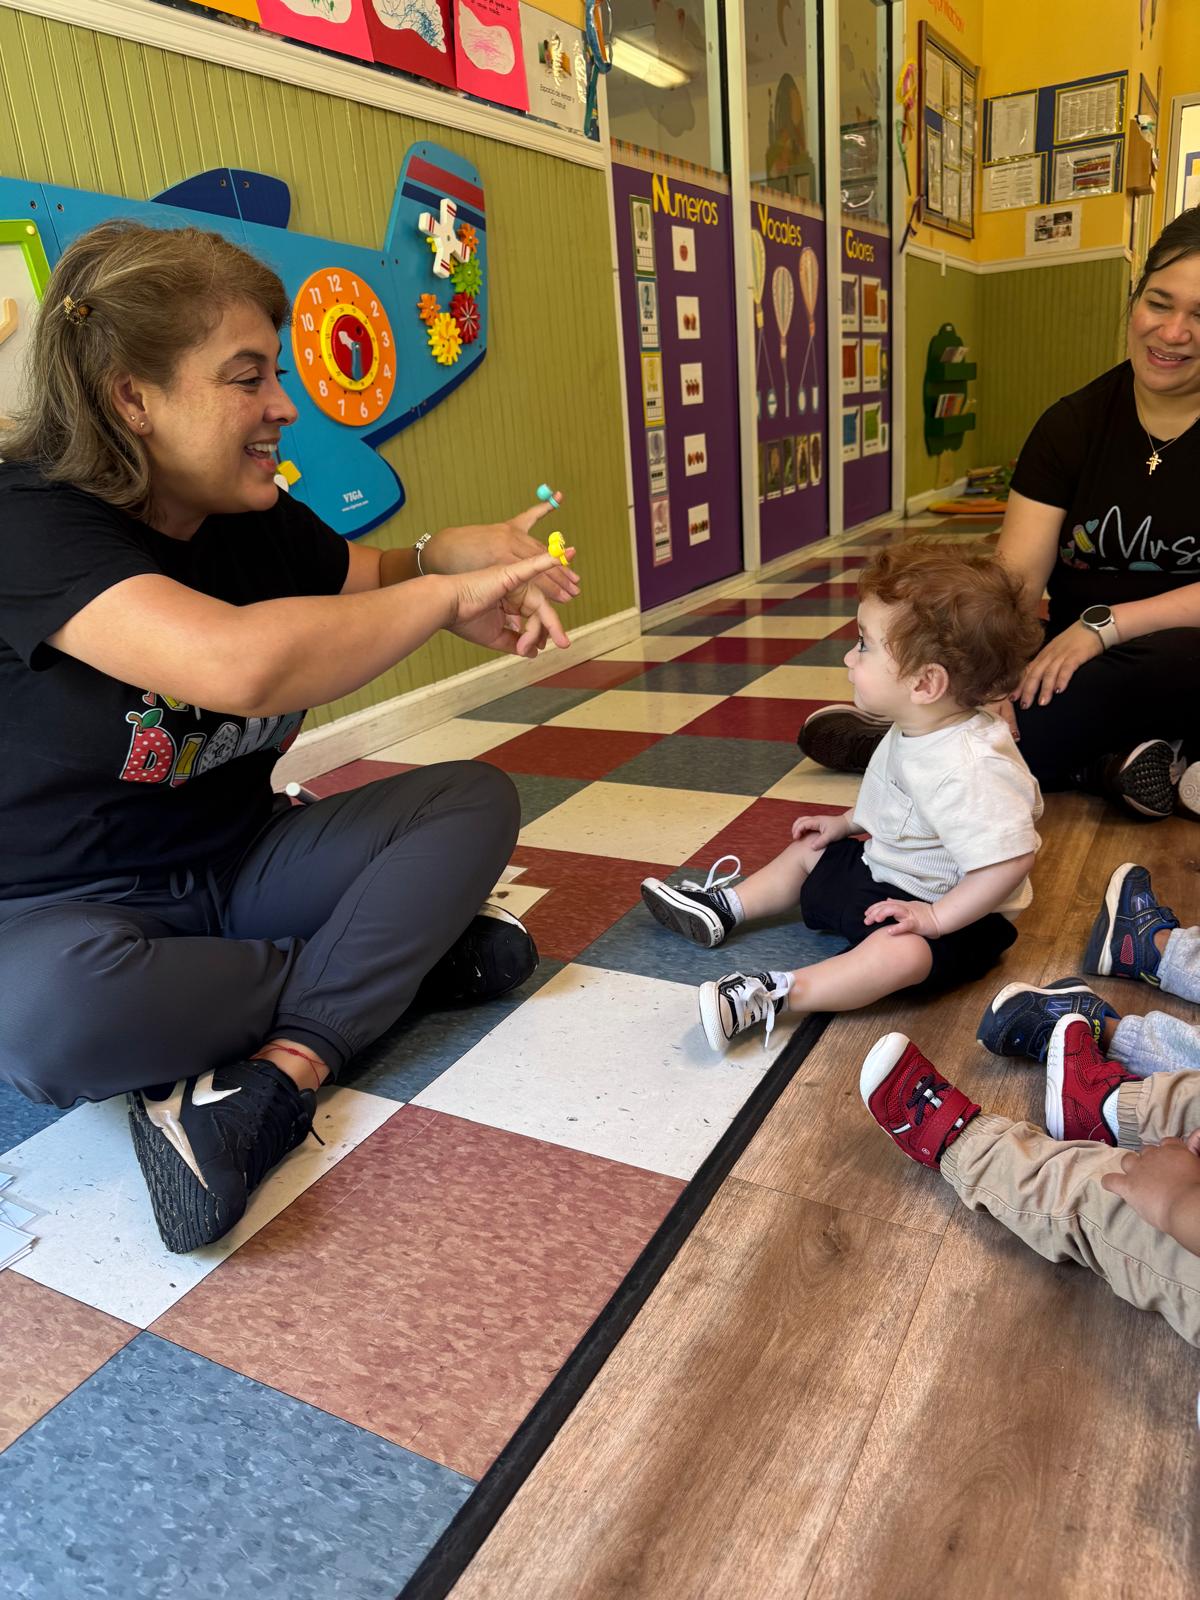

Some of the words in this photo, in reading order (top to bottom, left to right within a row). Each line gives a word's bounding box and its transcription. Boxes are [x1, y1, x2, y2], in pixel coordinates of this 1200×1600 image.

[652, 172, 718, 225] Numeros
[758, 203, 803, 248] Vocales
[845, 229, 875, 263] Colores
[326, 273, 343, 292] 12
[351, 281, 360, 297] 1
[308, 287, 323, 305] 11
[370, 300, 380, 318] 2
[300, 312, 315, 332] 10
[381, 330, 390, 348] 3
[304, 347, 314, 366] 9
[383, 363, 392, 379] 4
[318, 379, 329, 397] 8
[375, 388, 384, 405] 5
[337, 399, 346, 417] 7
[360, 402, 369, 418] 6
